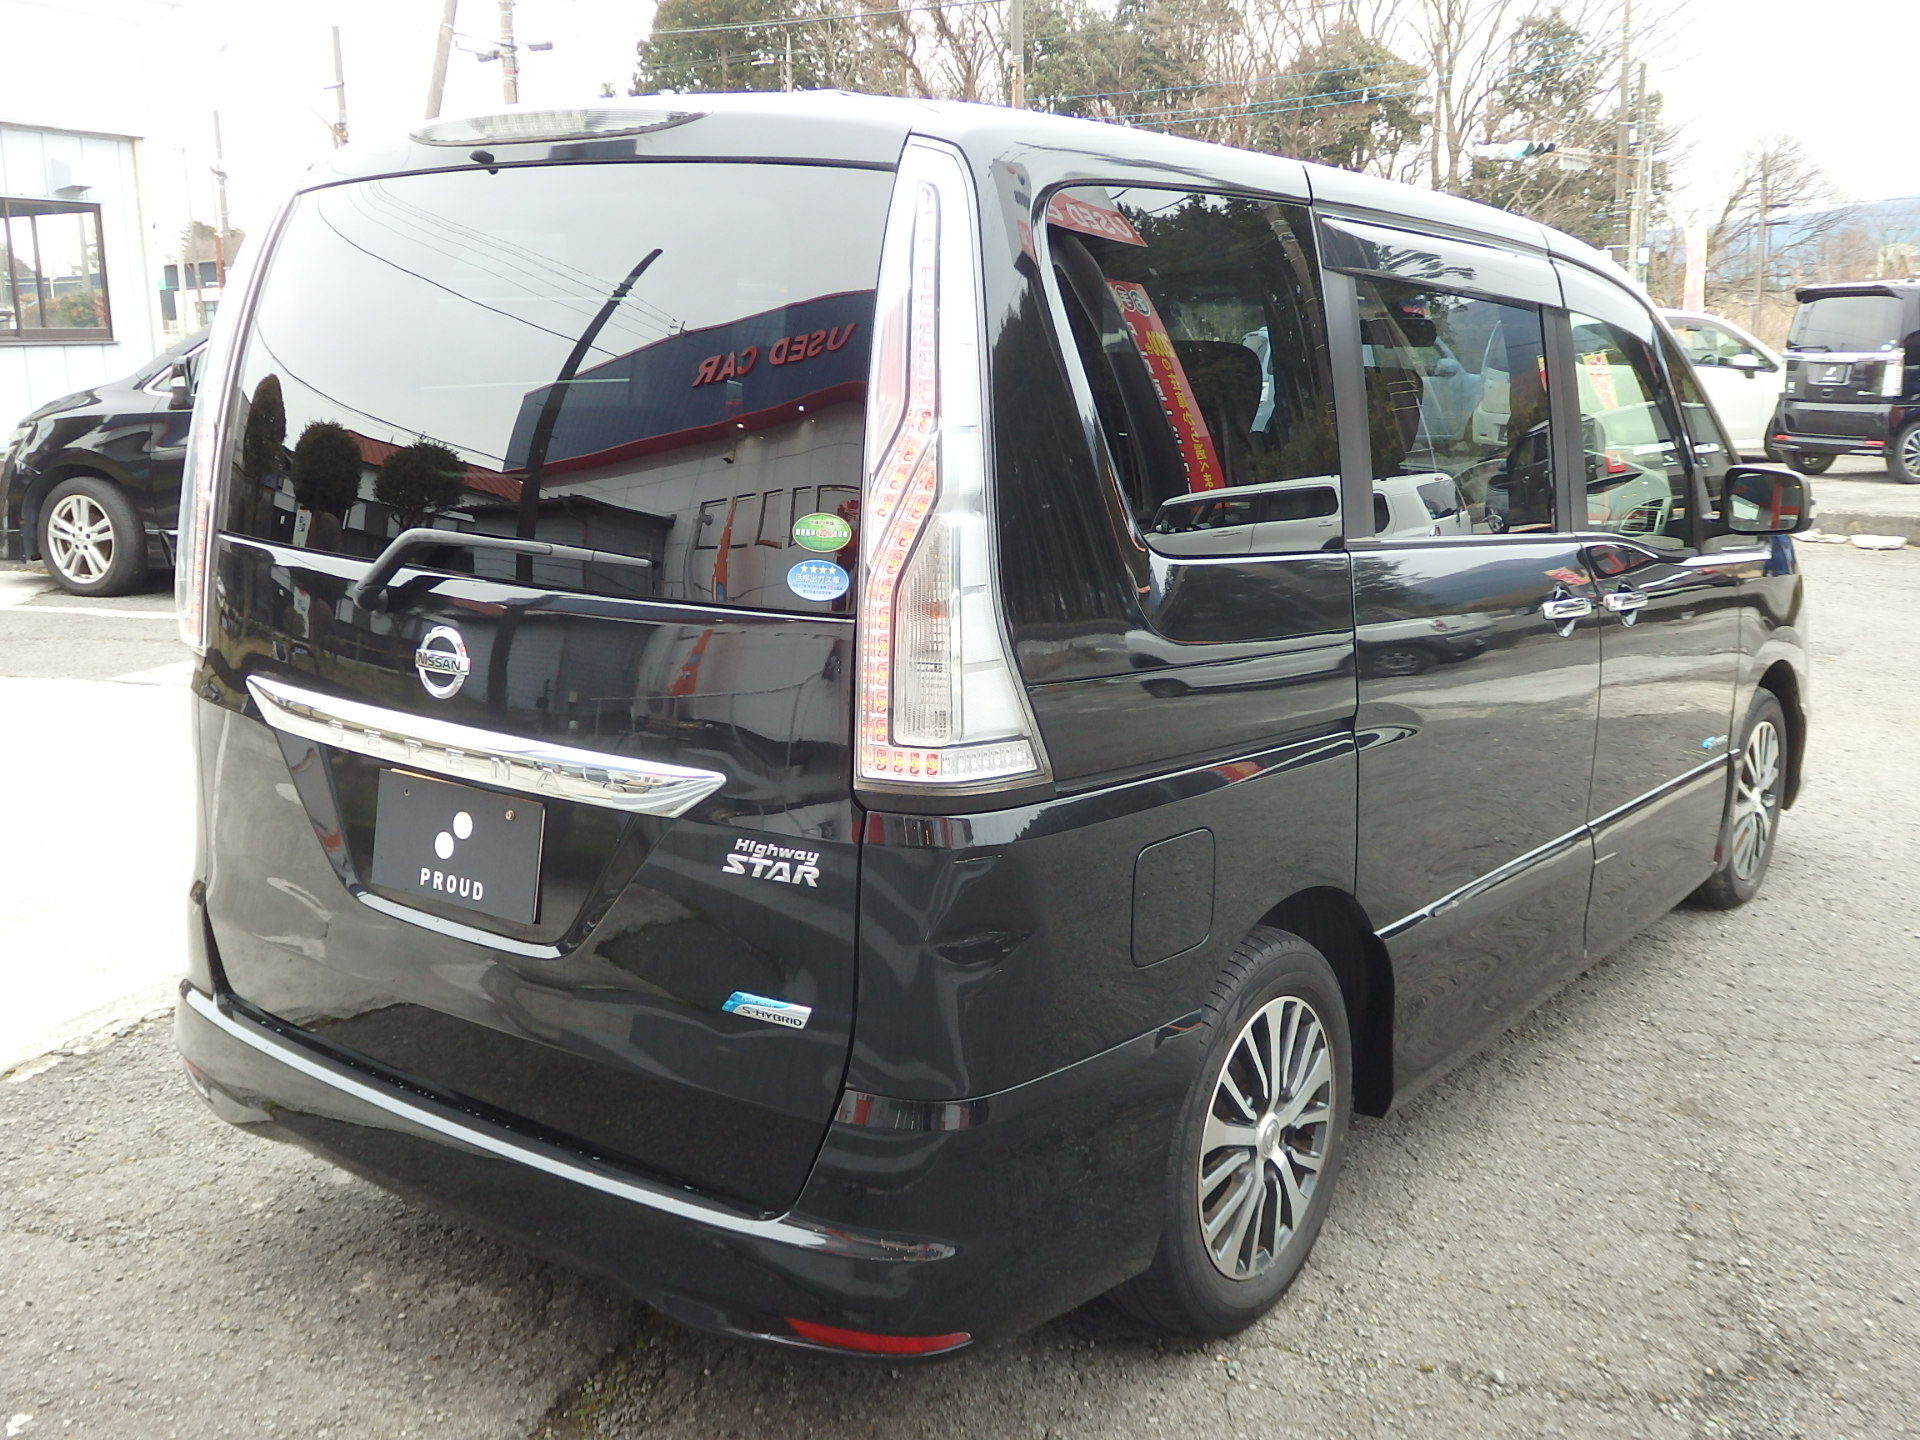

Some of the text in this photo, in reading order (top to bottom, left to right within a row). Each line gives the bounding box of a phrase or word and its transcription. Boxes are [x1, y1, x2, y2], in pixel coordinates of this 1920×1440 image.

[417, 651, 461, 670] NISSAN
[327, 719, 561, 790] SERENA
[734, 838, 820, 866] Highway
[420, 867, 483, 900] PROUD
[722, 853, 820, 888] STAR
